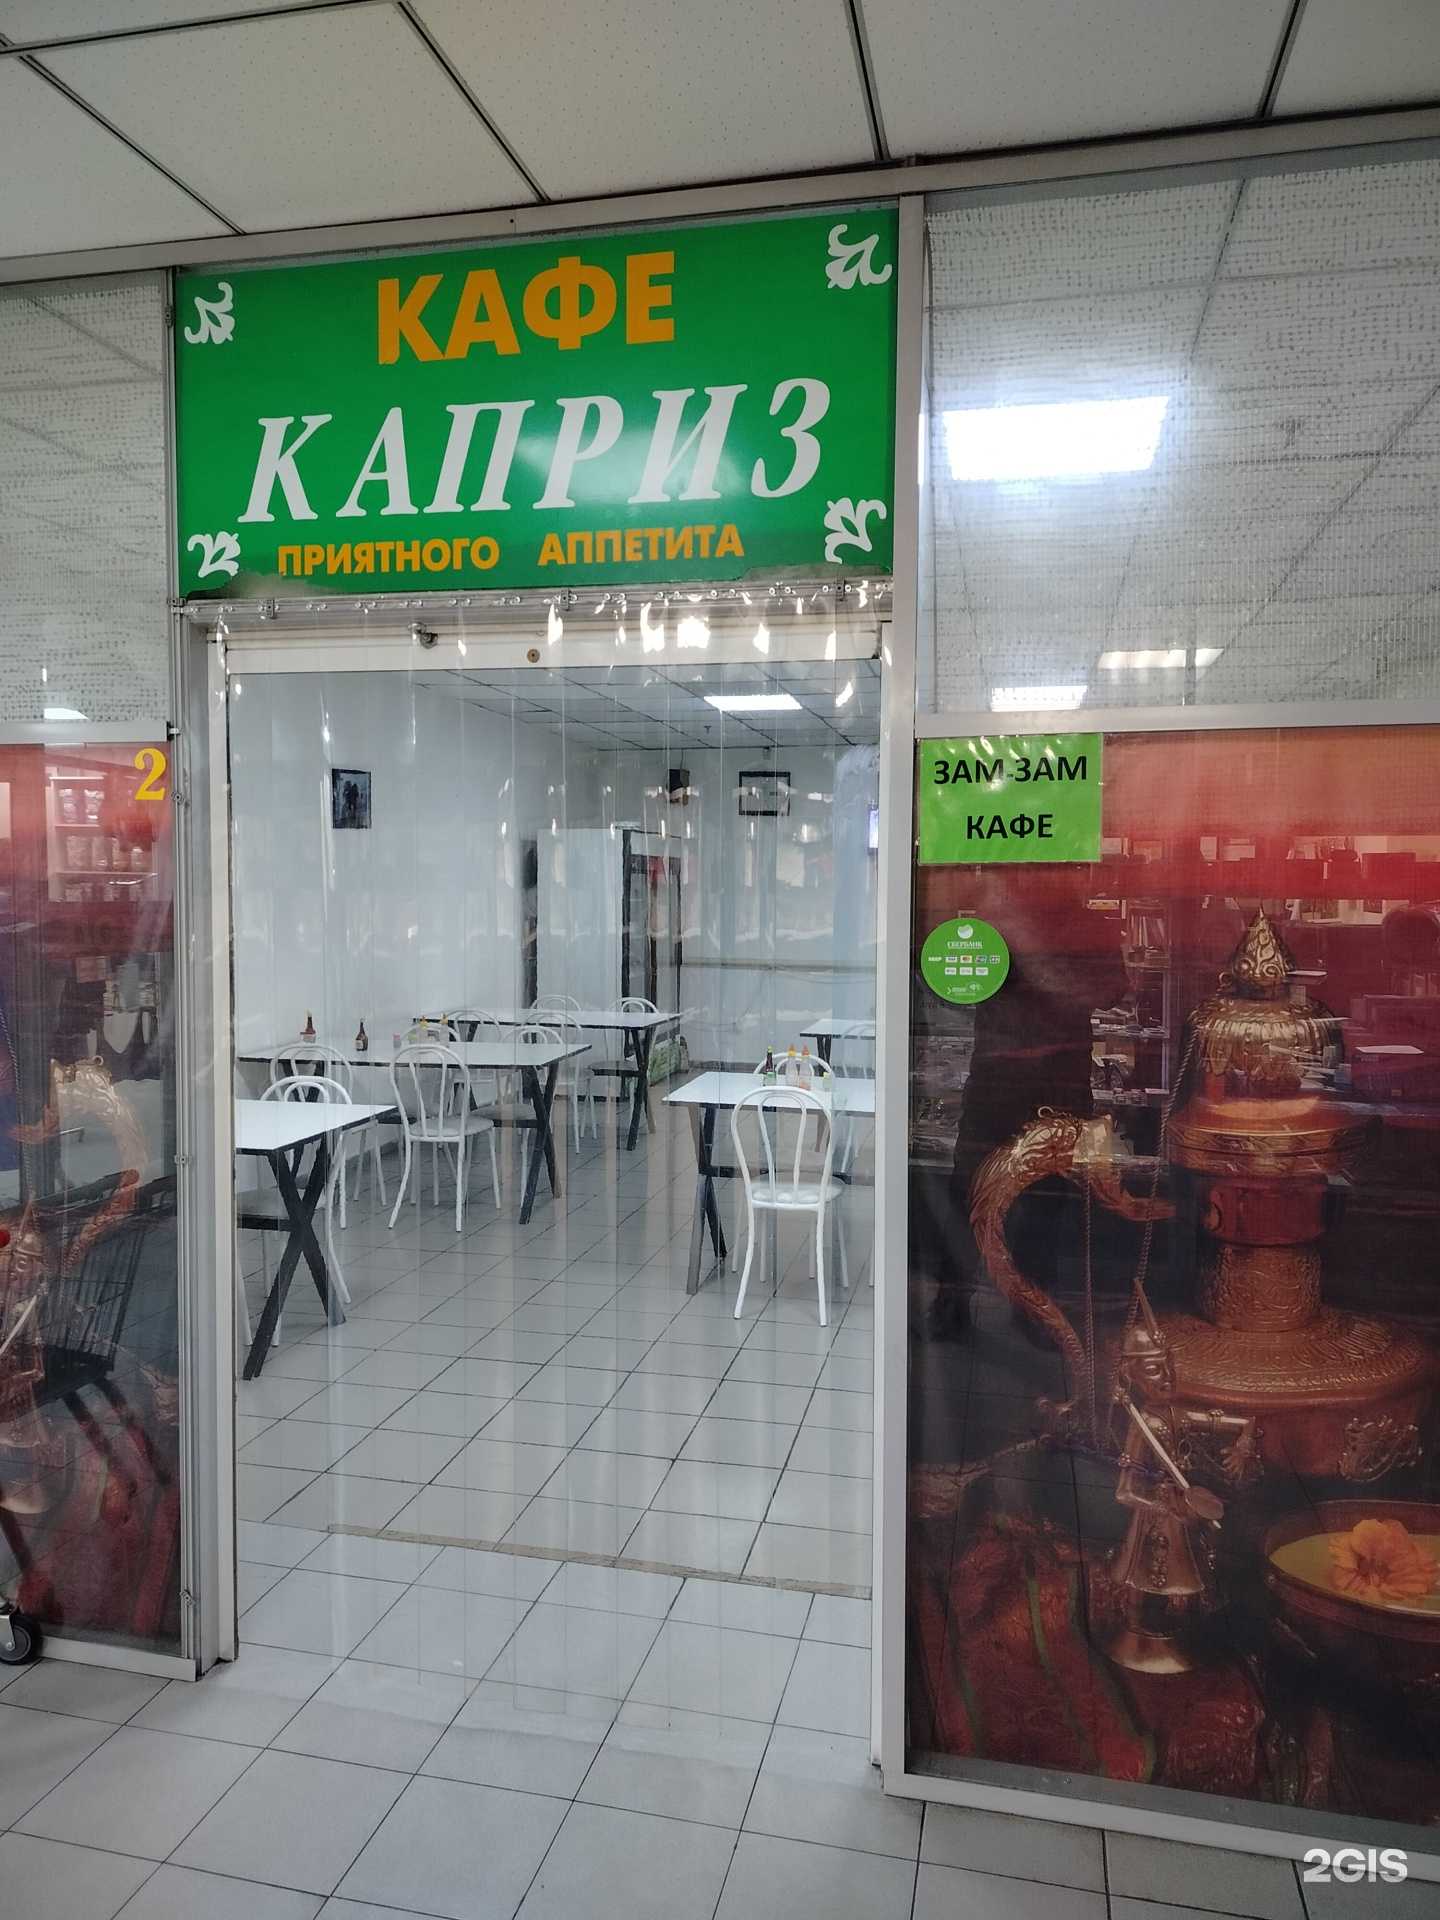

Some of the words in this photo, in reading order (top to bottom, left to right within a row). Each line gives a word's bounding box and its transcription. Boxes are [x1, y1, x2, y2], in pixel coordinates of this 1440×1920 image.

[378, 250, 675, 364] КАФЕ
[237, 378, 831, 523] КАПРИЗ
[277, 536, 500, 576] ПРИЯТНОГО
[537, 524, 745, 567] АППЕТИТА
[133, 748, 167, 800] 2
[934, 756, 1087, 784] ЗАМ-ЗАМ
[966, 813, 1054, 840] КАФЕ
